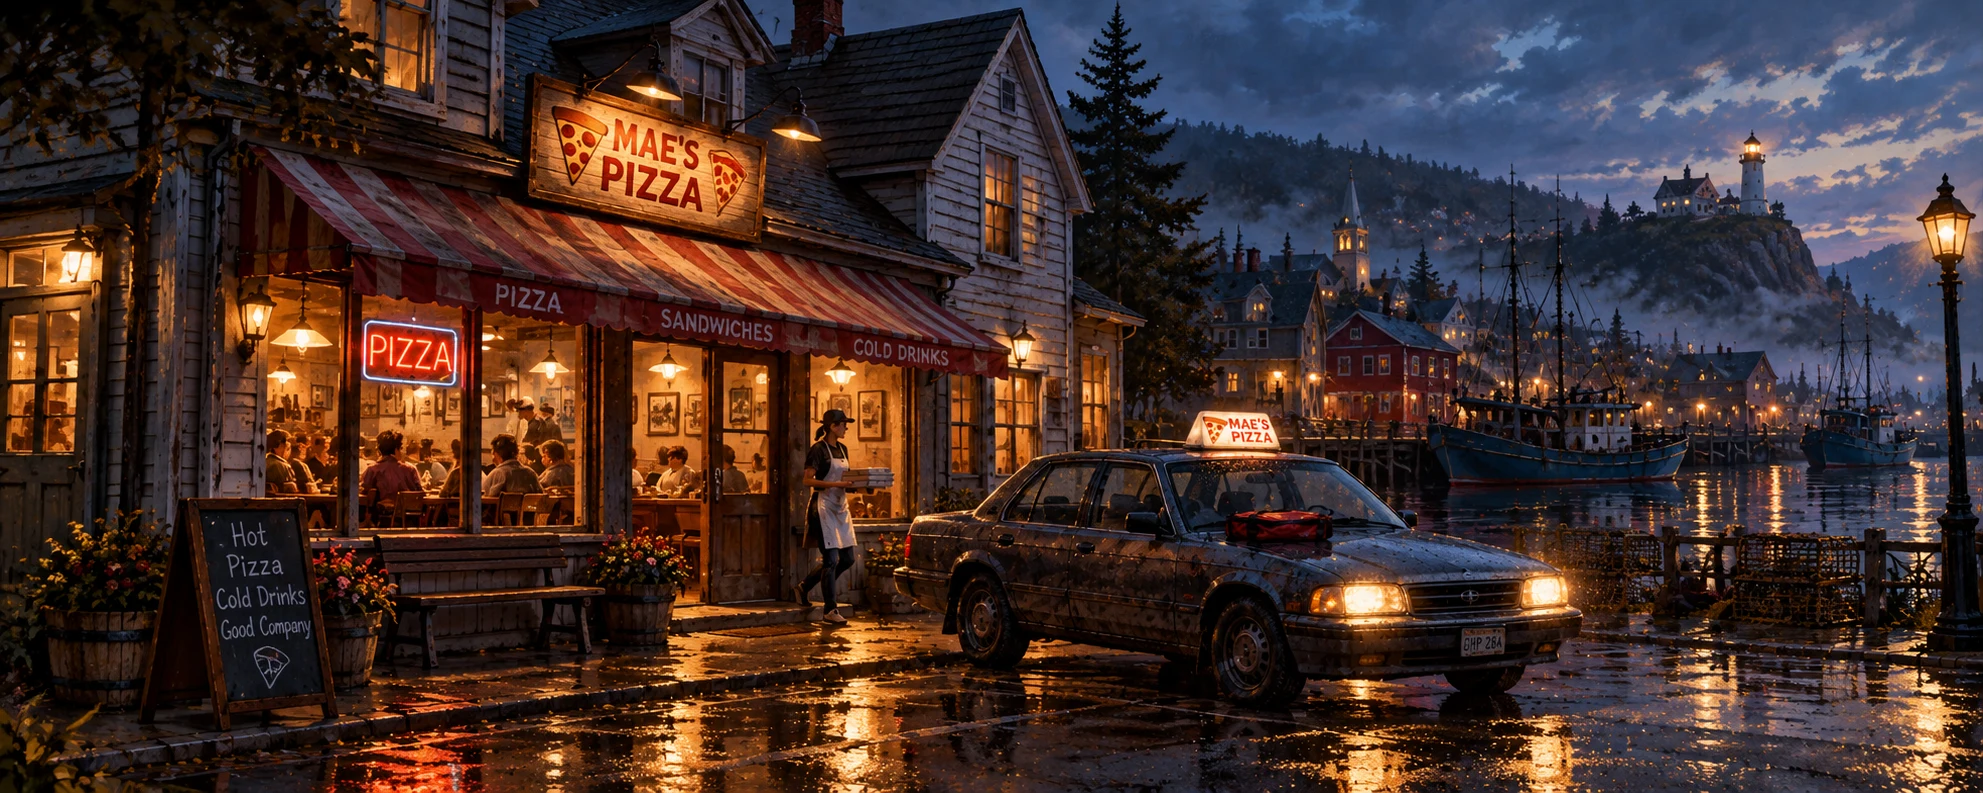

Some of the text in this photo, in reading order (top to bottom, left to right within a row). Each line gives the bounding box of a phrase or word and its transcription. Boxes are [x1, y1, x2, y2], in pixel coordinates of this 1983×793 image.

[612, 118, 700, 170] MAE'S
[601, 155, 703, 212] PIZZA
[495, 282, 564, 315] PIZZA
[661, 308, 774, 342] SANDWICHES
[369, 334, 452, 372] PIZZA
[853, 338, 949, 366] COLD DRINKS
[1228, 418, 1270, 430] MAE'S
[1231, 431, 1273, 443] PIZZA
[231, 521, 268, 547] Hot
[226, 553, 284, 578] Pizza
[216, 584, 306, 610] Cold Drinks
[220, 615, 311, 640] Good Company
